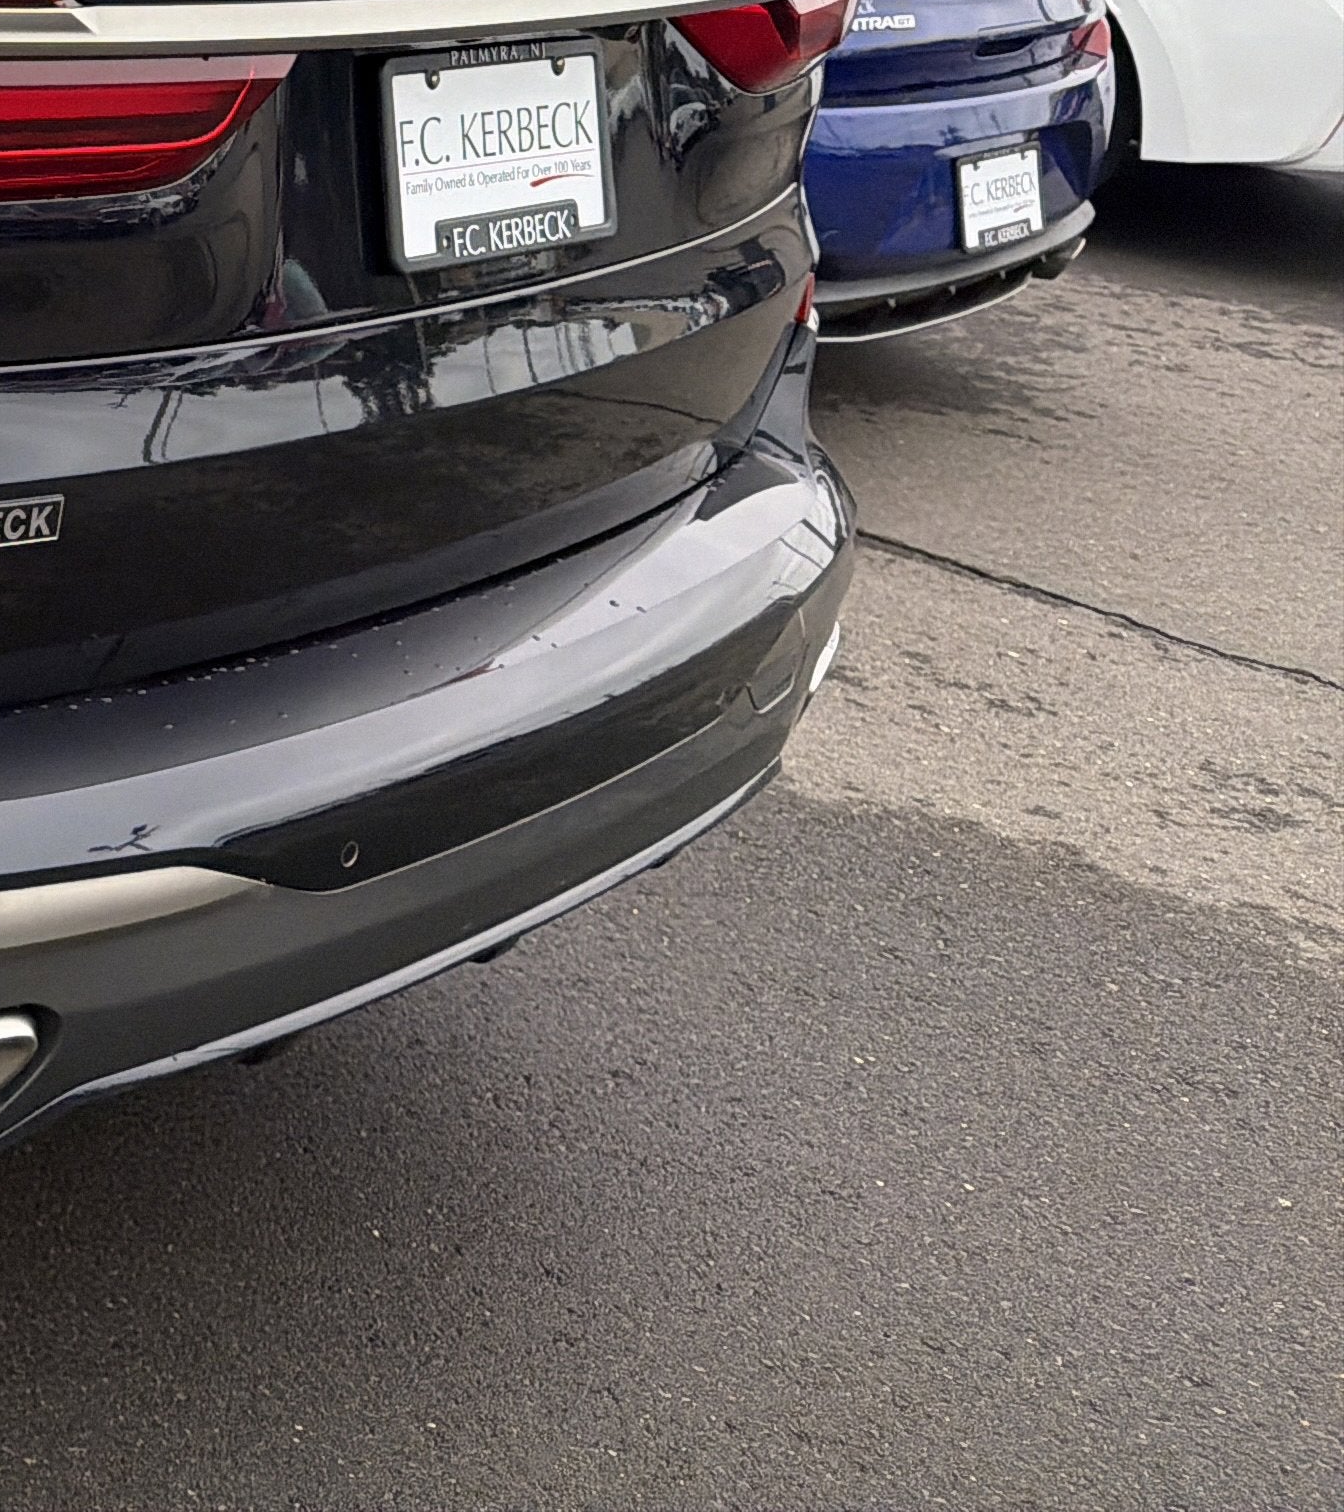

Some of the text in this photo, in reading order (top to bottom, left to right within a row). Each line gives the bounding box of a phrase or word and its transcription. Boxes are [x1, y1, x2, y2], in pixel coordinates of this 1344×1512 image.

[450, 42, 546, 66] PALMYRA, NJ
[399, 99, 594, 168] F.C. KERBECK
[405, 158, 592, 196] Family Owned & Operated For Over 100 Years
[986, 171, 1036, 202] KERBECK
[453, 208, 572, 258] F.C. KERBECK
